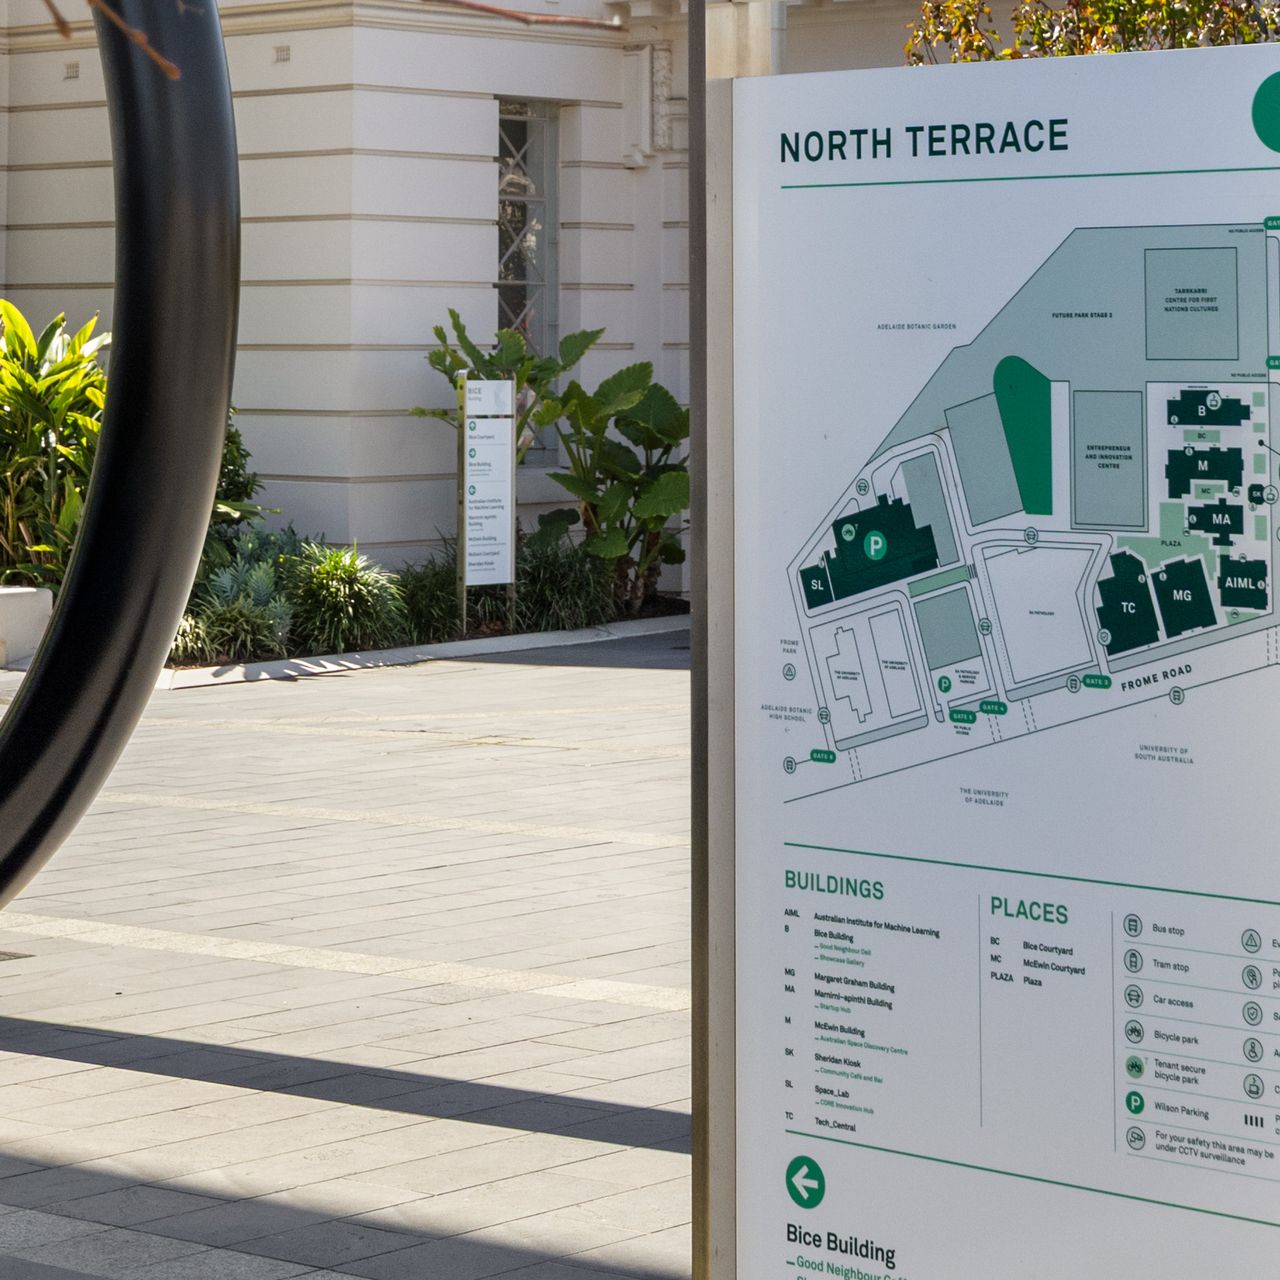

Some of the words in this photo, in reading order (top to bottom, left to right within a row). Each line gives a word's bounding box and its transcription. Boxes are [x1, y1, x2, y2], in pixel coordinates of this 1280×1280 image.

[780, 128, 892, 162] NORTH
[905, 118, 1068, 157] TERRACE
[1198, 405, 1206, 416] B
[1198, 460, 1208, 471] M
[1212, 513, 1231, 525] MA
[811, 579, 824, 590] SL
[1225, 577, 1255, 589] AIML
[1173, 589, 1192, 601] MG
[1122, 602, 1136, 613] TC
[1122, 673, 1159, 691] FROME
[1163, 664, 1192, 679] ROAD
[1139, 744, 1177, 754] UNIVERSITY
[1180, 747, 1189, 755] OF
[1134, 753, 1156, 762] SOUTH
[1157, 755, 1194, 765] AUSTRALIA
[960, 787, 972, 795] THE
[974, 788, 1009, 798] UNIVERSITY
[974, 797, 1004, 807] ADELAIDE
[785, 869, 884, 900] BUILDINGS
[991, 896, 1068, 924] PLACES
[784, 908, 800, 918] AIML
[814, 913, 846, 924] Australian
[847, 916, 873, 928] Institute
[874, 920, 883, 929] for
[884, 922, 911, 934] Machine
[912, 926, 940, 939] Learning
[1153, 923, 1167, 934] Bus
[1168, 926, 1185, 936] stop
[785, 925, 789, 933] B
[814, 929, 828, 938] Bice
[829, 931, 854, 944] Building
[991, 936, 1000, 945] BC
[1023, 941, 1038, 951] Bice
[1039, 943, 1073, 956] Courtyard
[991, 954, 1002, 963] MC
[1023, 959, 1050, 970] McEwin
[1051, 963, 1086, 975] Courtyard
[1153, 959, 1172, 970] Tram
[1173, 962, 1190, 973] stop
[785, 968, 795, 976] MG
[815, 973, 843, 984] Margaret
[844, 977, 868, 988] Graham
[869, 980, 895, 993] Building
[991, 972, 1014, 982] PLAZA
[1023, 976, 1042, 986] Plaza
[785, 985, 795, 993] MA
[867, 996, 893, 1010] Building
[1153, 995, 1166, 1005] Car
[1168, 998, 1194, 1008] access
[785, 1016, 791, 1024] M
[815, 1021, 839, 1033] McEwin
[840, 1025, 865, 1038] Building
[1154, 1030, 1181, 1043] Bicycle
[1182, 1033, 1199, 1045] park
[785, 1048, 794, 1056] SK
[815, 1053, 842, 1065] Sheridan
[843, 1059, 861, 1068] Kiosk
[1154, 1059, 1179, 1071] Tenant
[1181, 1064, 1206, 1075] secure
[785, 1080, 793, 1088] SL
[1154, 1071, 1181, 1084] bicycle
[1182, 1075, 1199, 1086] park
[785, 1112, 793, 1120] TC
[1154, 1101, 1180, 1114] Wilson
[1181, 1106, 1209, 1120] Parking
[1156, 1130, 1168, 1140] For
[1169, 1134, 1186, 1145] your
[1187, 1135, 1211, 1149] safety
[1212, 1140, 1227, 1150] this
[1228, 1144, 1245, 1153] area
[1247, 1147, 1263, 1159] may
[1264, 1150, 1274, 1159] be
[1156, 1142, 1177, 1153] under
[1179, 1145, 1199, 1157] CCTV
[1200, 1149, 1246, 1166] surveillance
[787, 1223, 822, 1248] Bice
[827, 1231, 896, 1270] Building
[797, 1255, 823, 1272] Good
